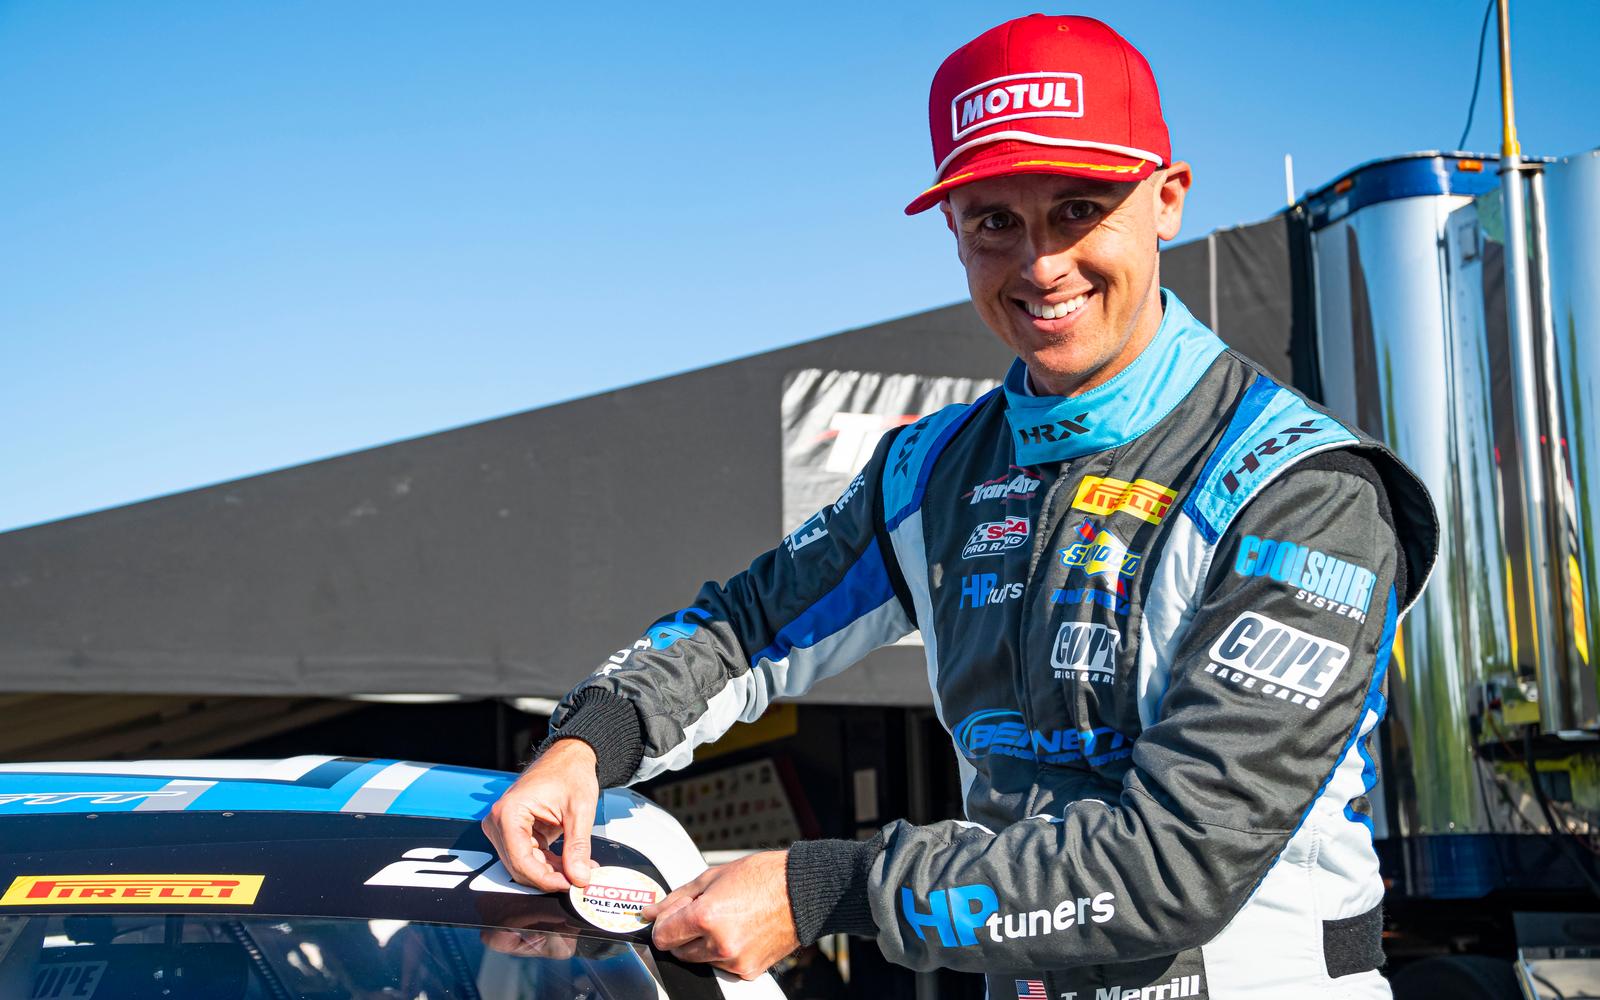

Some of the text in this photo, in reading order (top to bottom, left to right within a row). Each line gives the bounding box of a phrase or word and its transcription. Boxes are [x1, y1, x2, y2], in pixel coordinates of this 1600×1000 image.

[961, 82, 1071, 127] MOTUL
[1018, 412, 1091, 445] HRX
[1222, 420, 1323, 496] HRX
[964, 543, 988, 556] PRO
[1218, 617, 1345, 690] COPE
[1054, 670, 1076, 680] RCE
[1204, 663, 1321, 710] RACE CARS
[26, 880, 240, 898] PIRELLI
[586, 886, 652, 902] MOTUL
[583, 898, 644, 911] POLE AWAR
[32, 965, 101, 999] OPE
[1095, 975, 1200, 1000] Merrill
